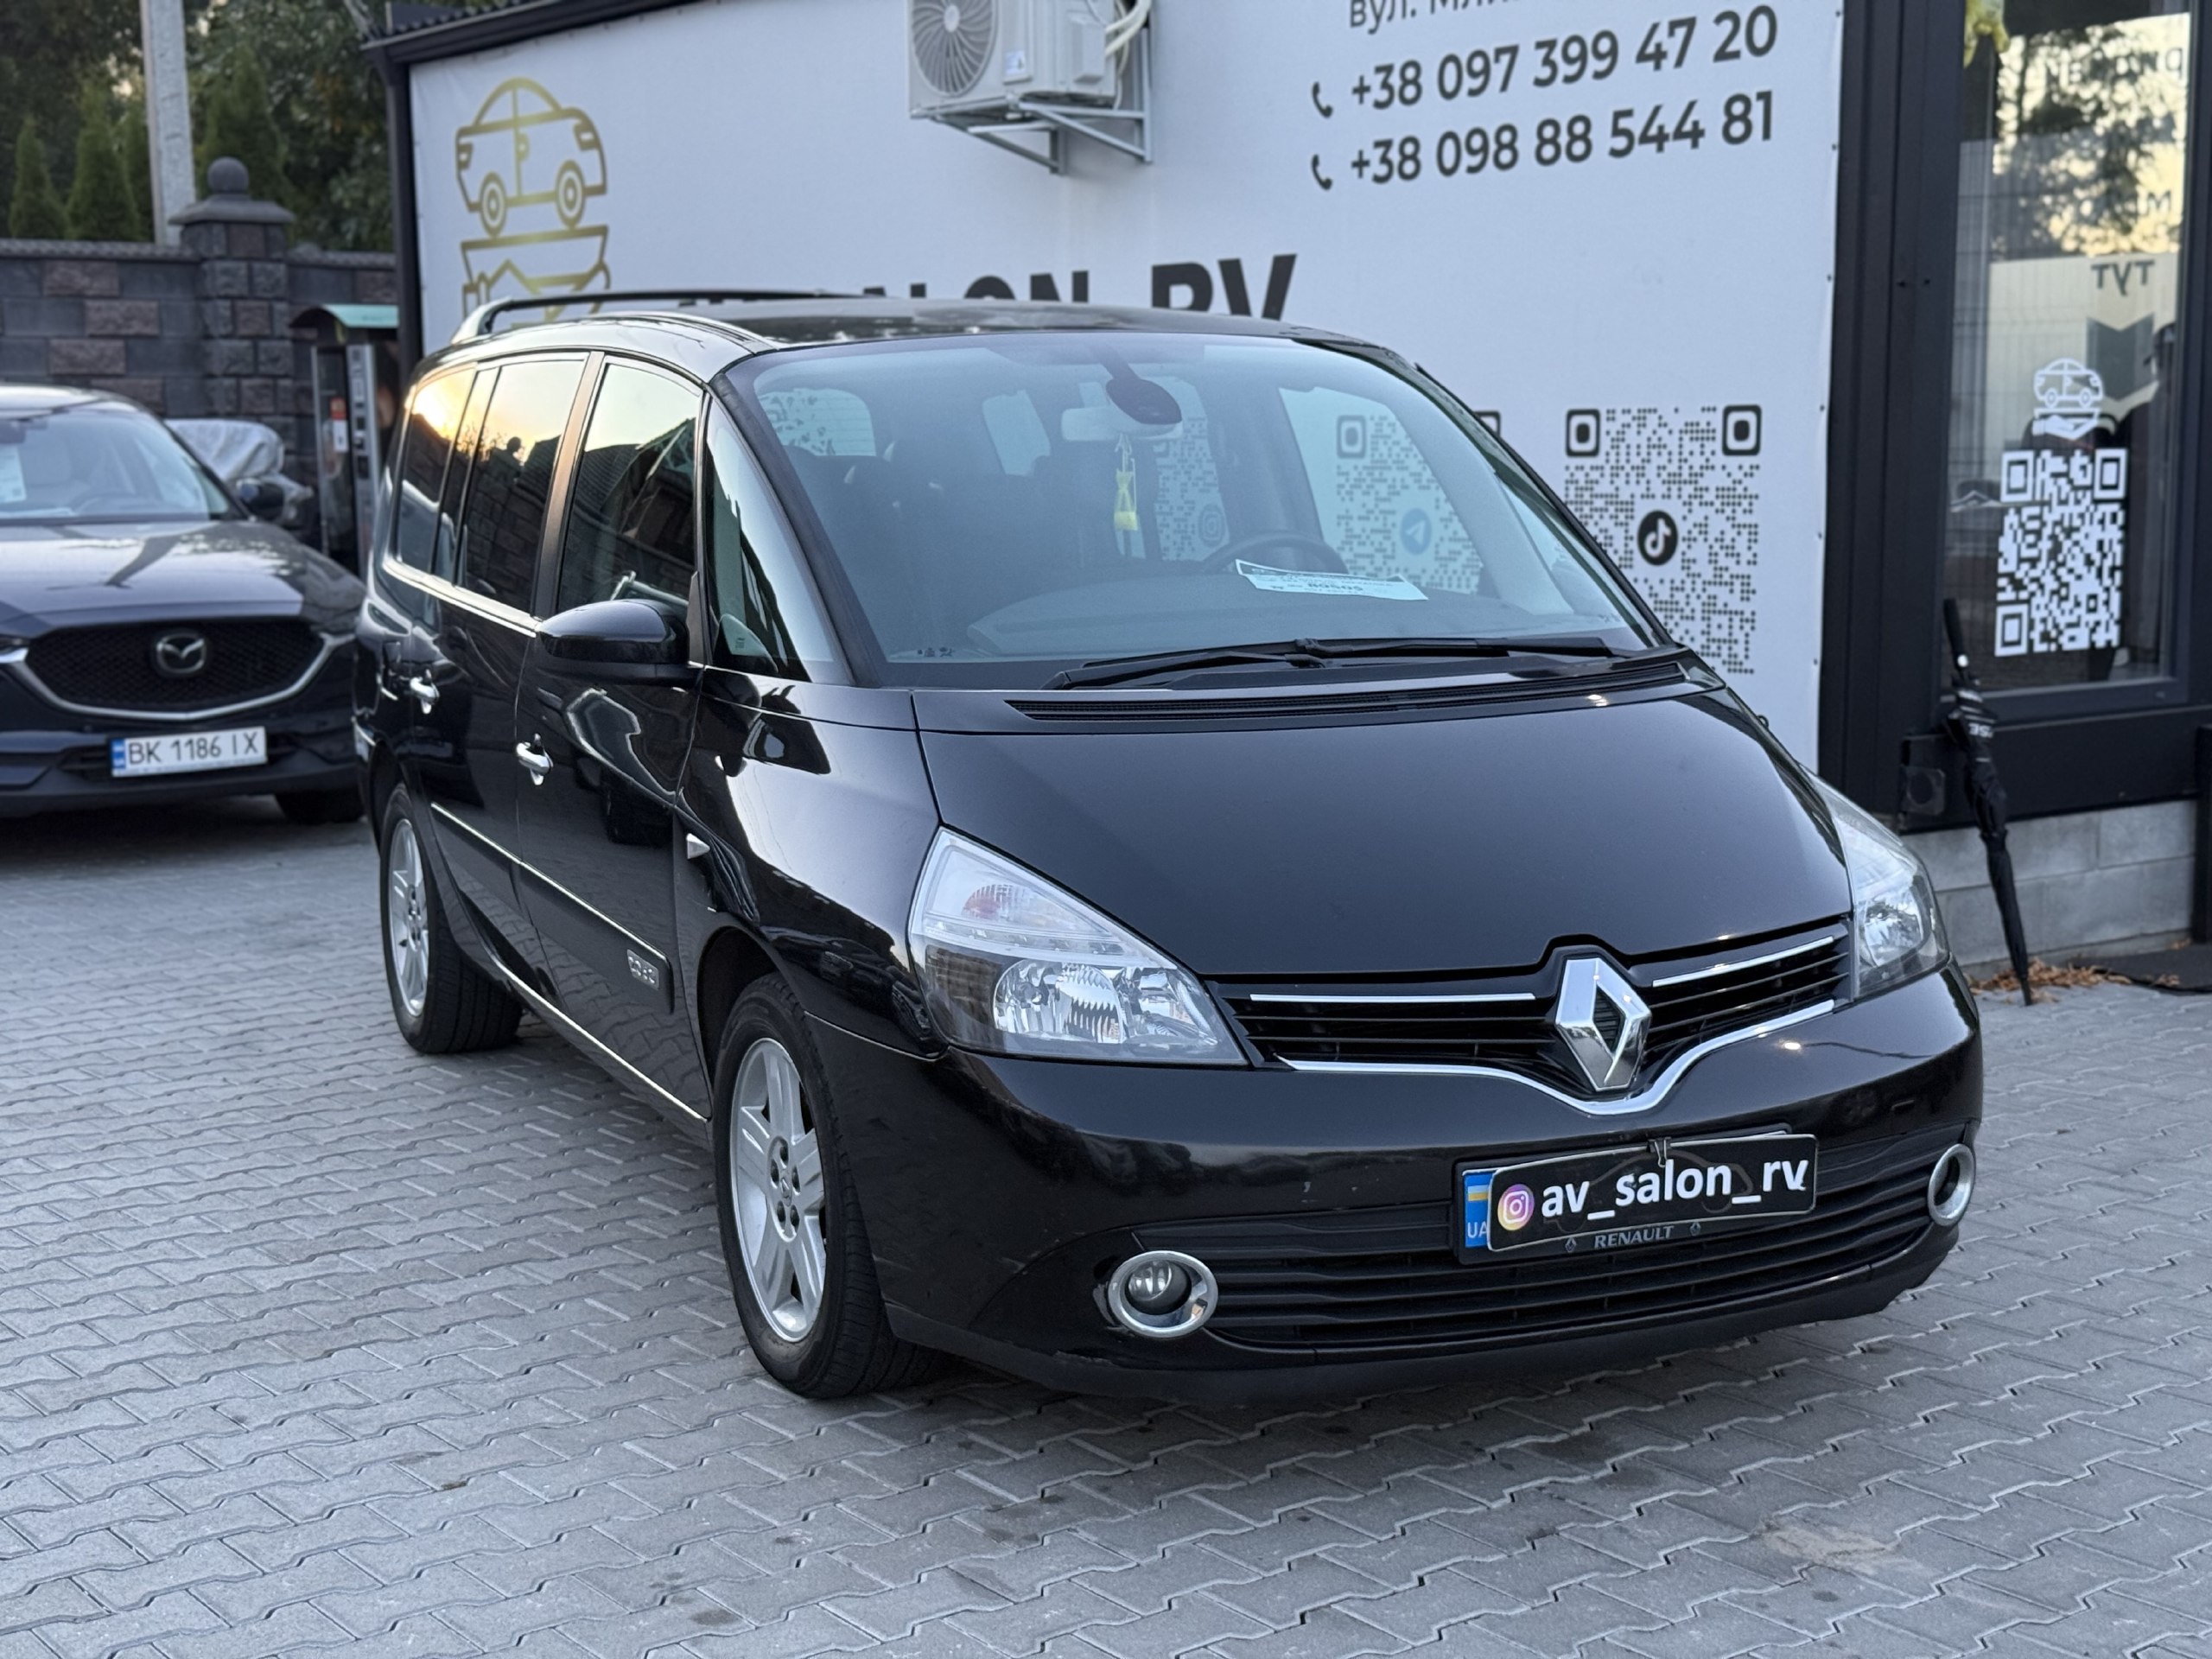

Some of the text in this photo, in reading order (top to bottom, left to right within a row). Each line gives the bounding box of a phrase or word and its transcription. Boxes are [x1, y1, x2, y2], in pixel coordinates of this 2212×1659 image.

[1351, 4, 1778, 111] +38 097 399 47 20
[1351, 90, 1774, 185] +38 098 88 544 81
[129, 741, 162, 766] BK
[170, 736, 222, 761] 1186
[1541, 1159, 1809, 1221] av_salon_rv
[1593, 1225, 1675, 1249] RENAULT
